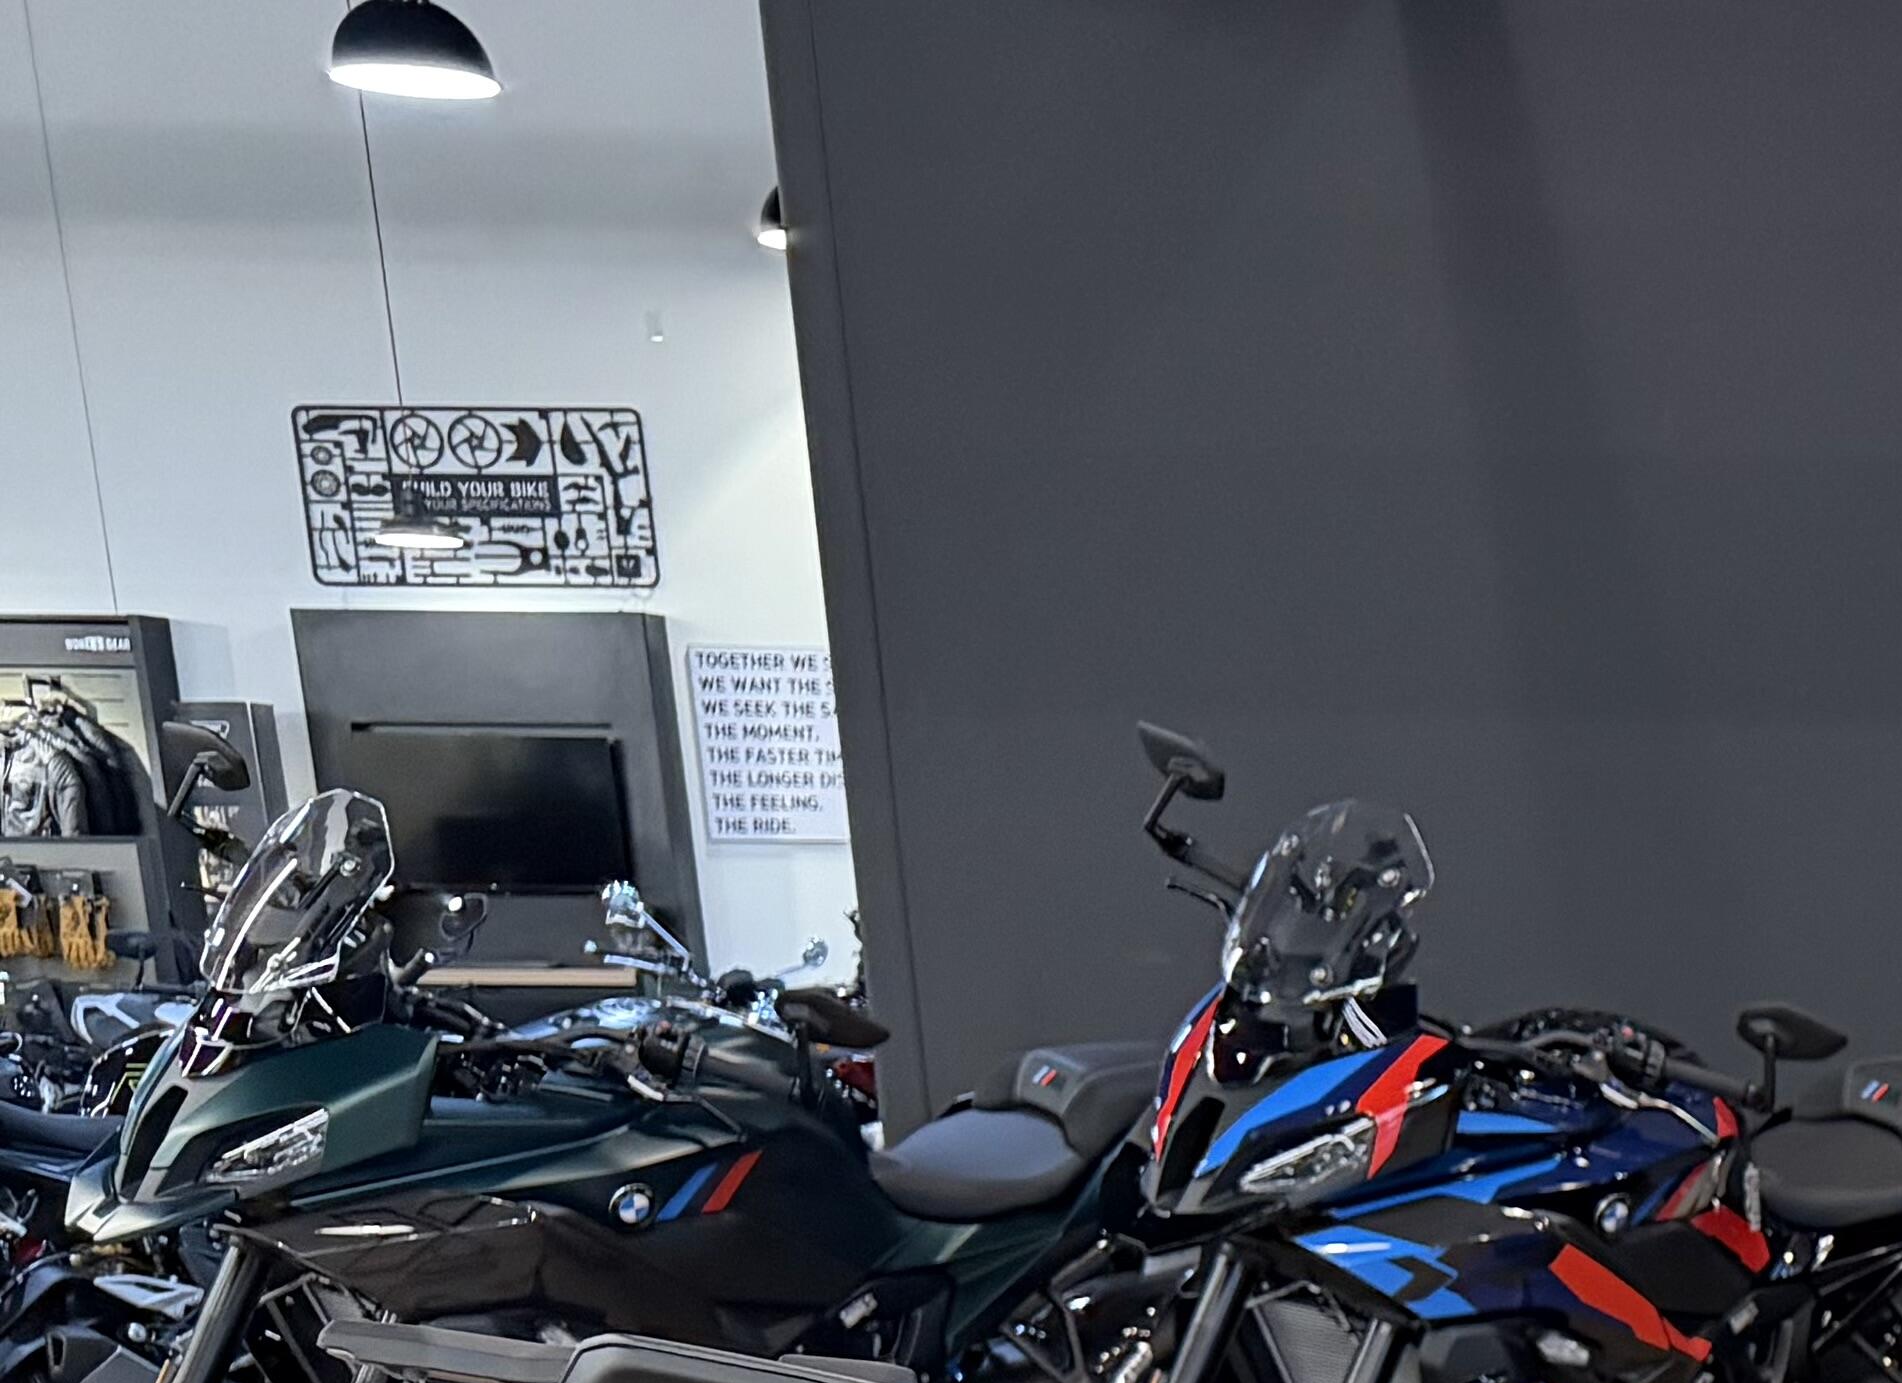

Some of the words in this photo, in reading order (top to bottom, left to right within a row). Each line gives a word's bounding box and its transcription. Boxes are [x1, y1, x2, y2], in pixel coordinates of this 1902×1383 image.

[457, 481, 505, 498] YOUR
[510, 481, 550, 498] BIKE
[695, 651, 785, 671] TOGETHER
[790, 654, 818, 672] WE
[699, 675, 726, 693] WE
[731, 676, 782, 695] WANT
[786, 678, 822, 696] THE
[702, 699, 729, 717] WE
[733, 700, 777, 718] SEEK
[782, 701, 817, 719] THE
[704, 723, 737, 740] THE
[707, 746, 741, 764] THE
[745, 746, 810, 765] FASTER
[710, 769, 743, 788] THE
[747, 769, 815, 788] LONGER
[712, 792, 746, 812] THE
[715, 816, 748, 835] THE
